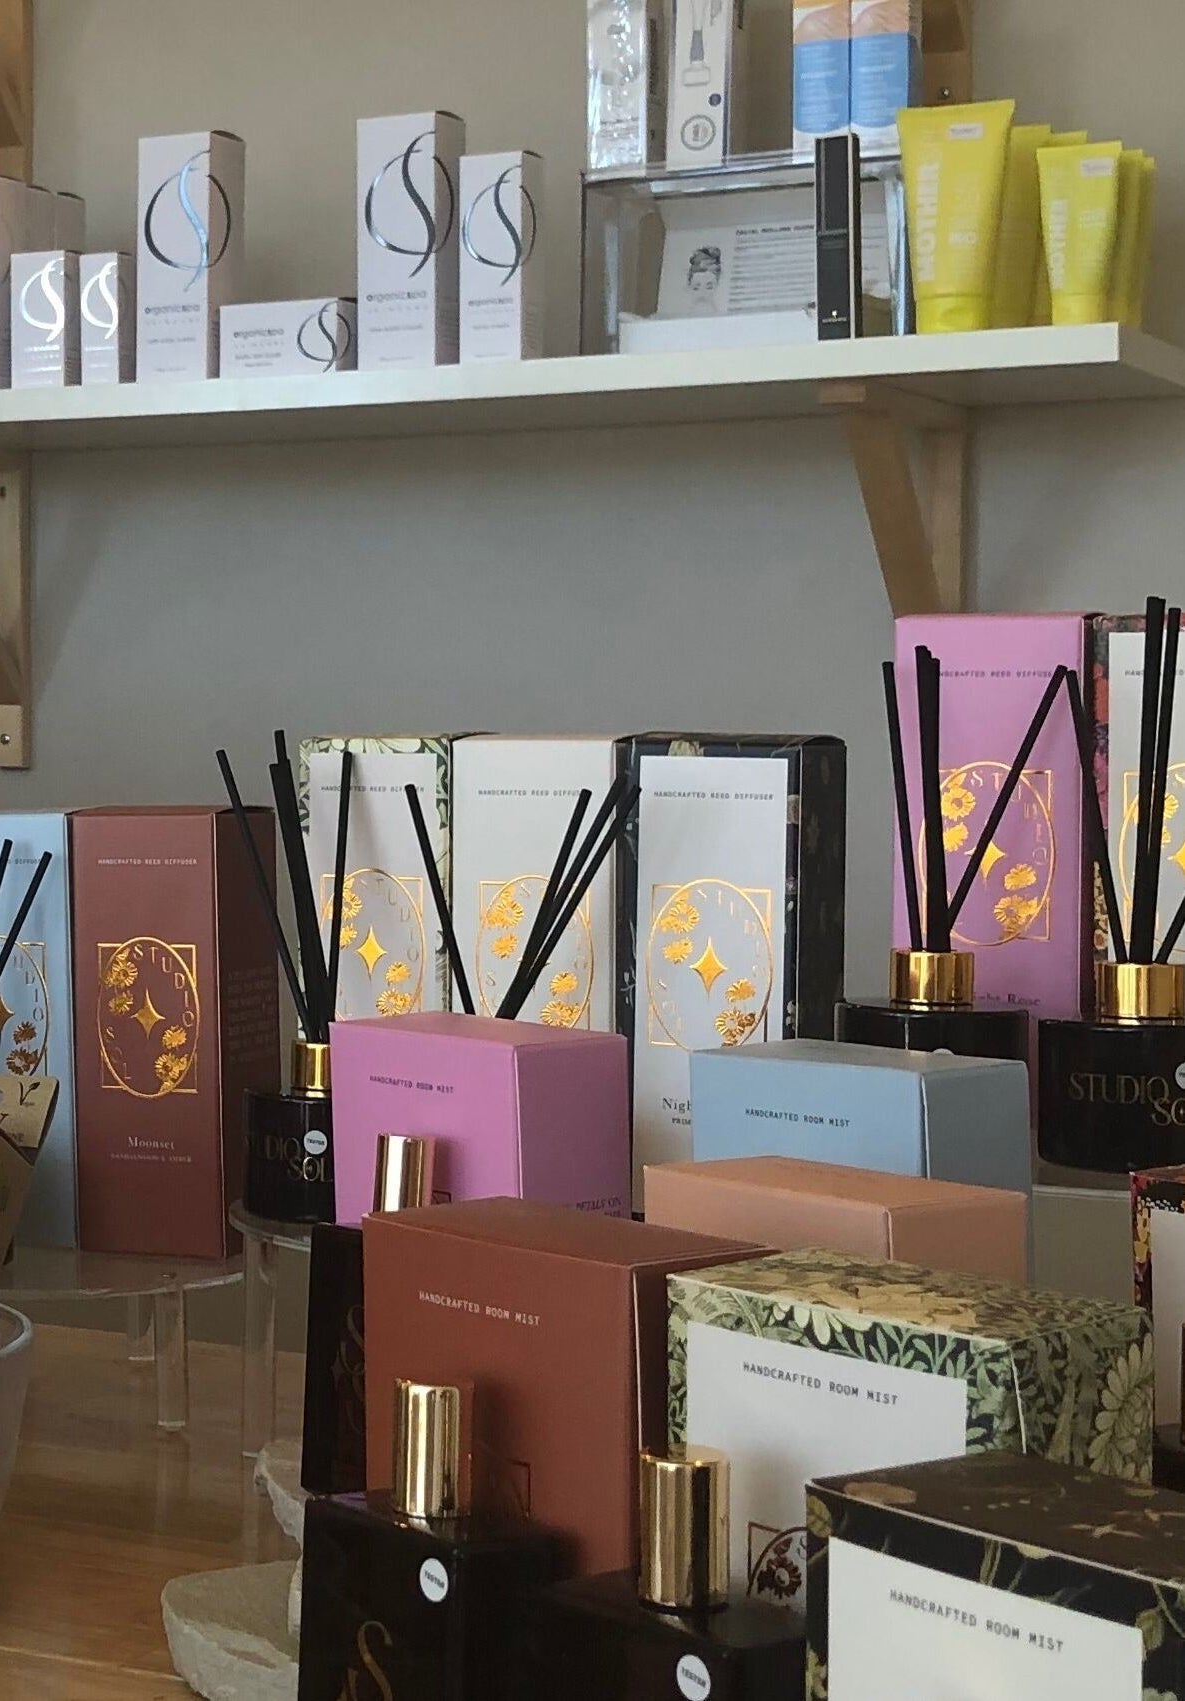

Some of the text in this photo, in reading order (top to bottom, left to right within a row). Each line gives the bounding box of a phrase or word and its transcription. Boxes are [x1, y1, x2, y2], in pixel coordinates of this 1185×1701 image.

[654, 791, 706, 799] HANDCRAFTED
[133, 944, 195, 1027] STUDIO
[370, 1075, 454, 1093] HANDCRAFTED ROOM MIST
[1070, 1073, 1169, 1105] STUDIO
[745, 1108, 850, 1127] HANDCRAFTED ROOM MIST
[1151, 1097, 1185, 1126] SO
[127, 1136, 176, 1150] Moonset
[287, 1155, 333, 1182] SOL
[419, 1290, 541, 1326] HANDCRAFTED ROOM MIST
[743, 1361, 899, 1406] HANDCRAFTED ROOM MIST
[890, 1589, 1064, 1652] HANDCRAFTED ROOM MIST
